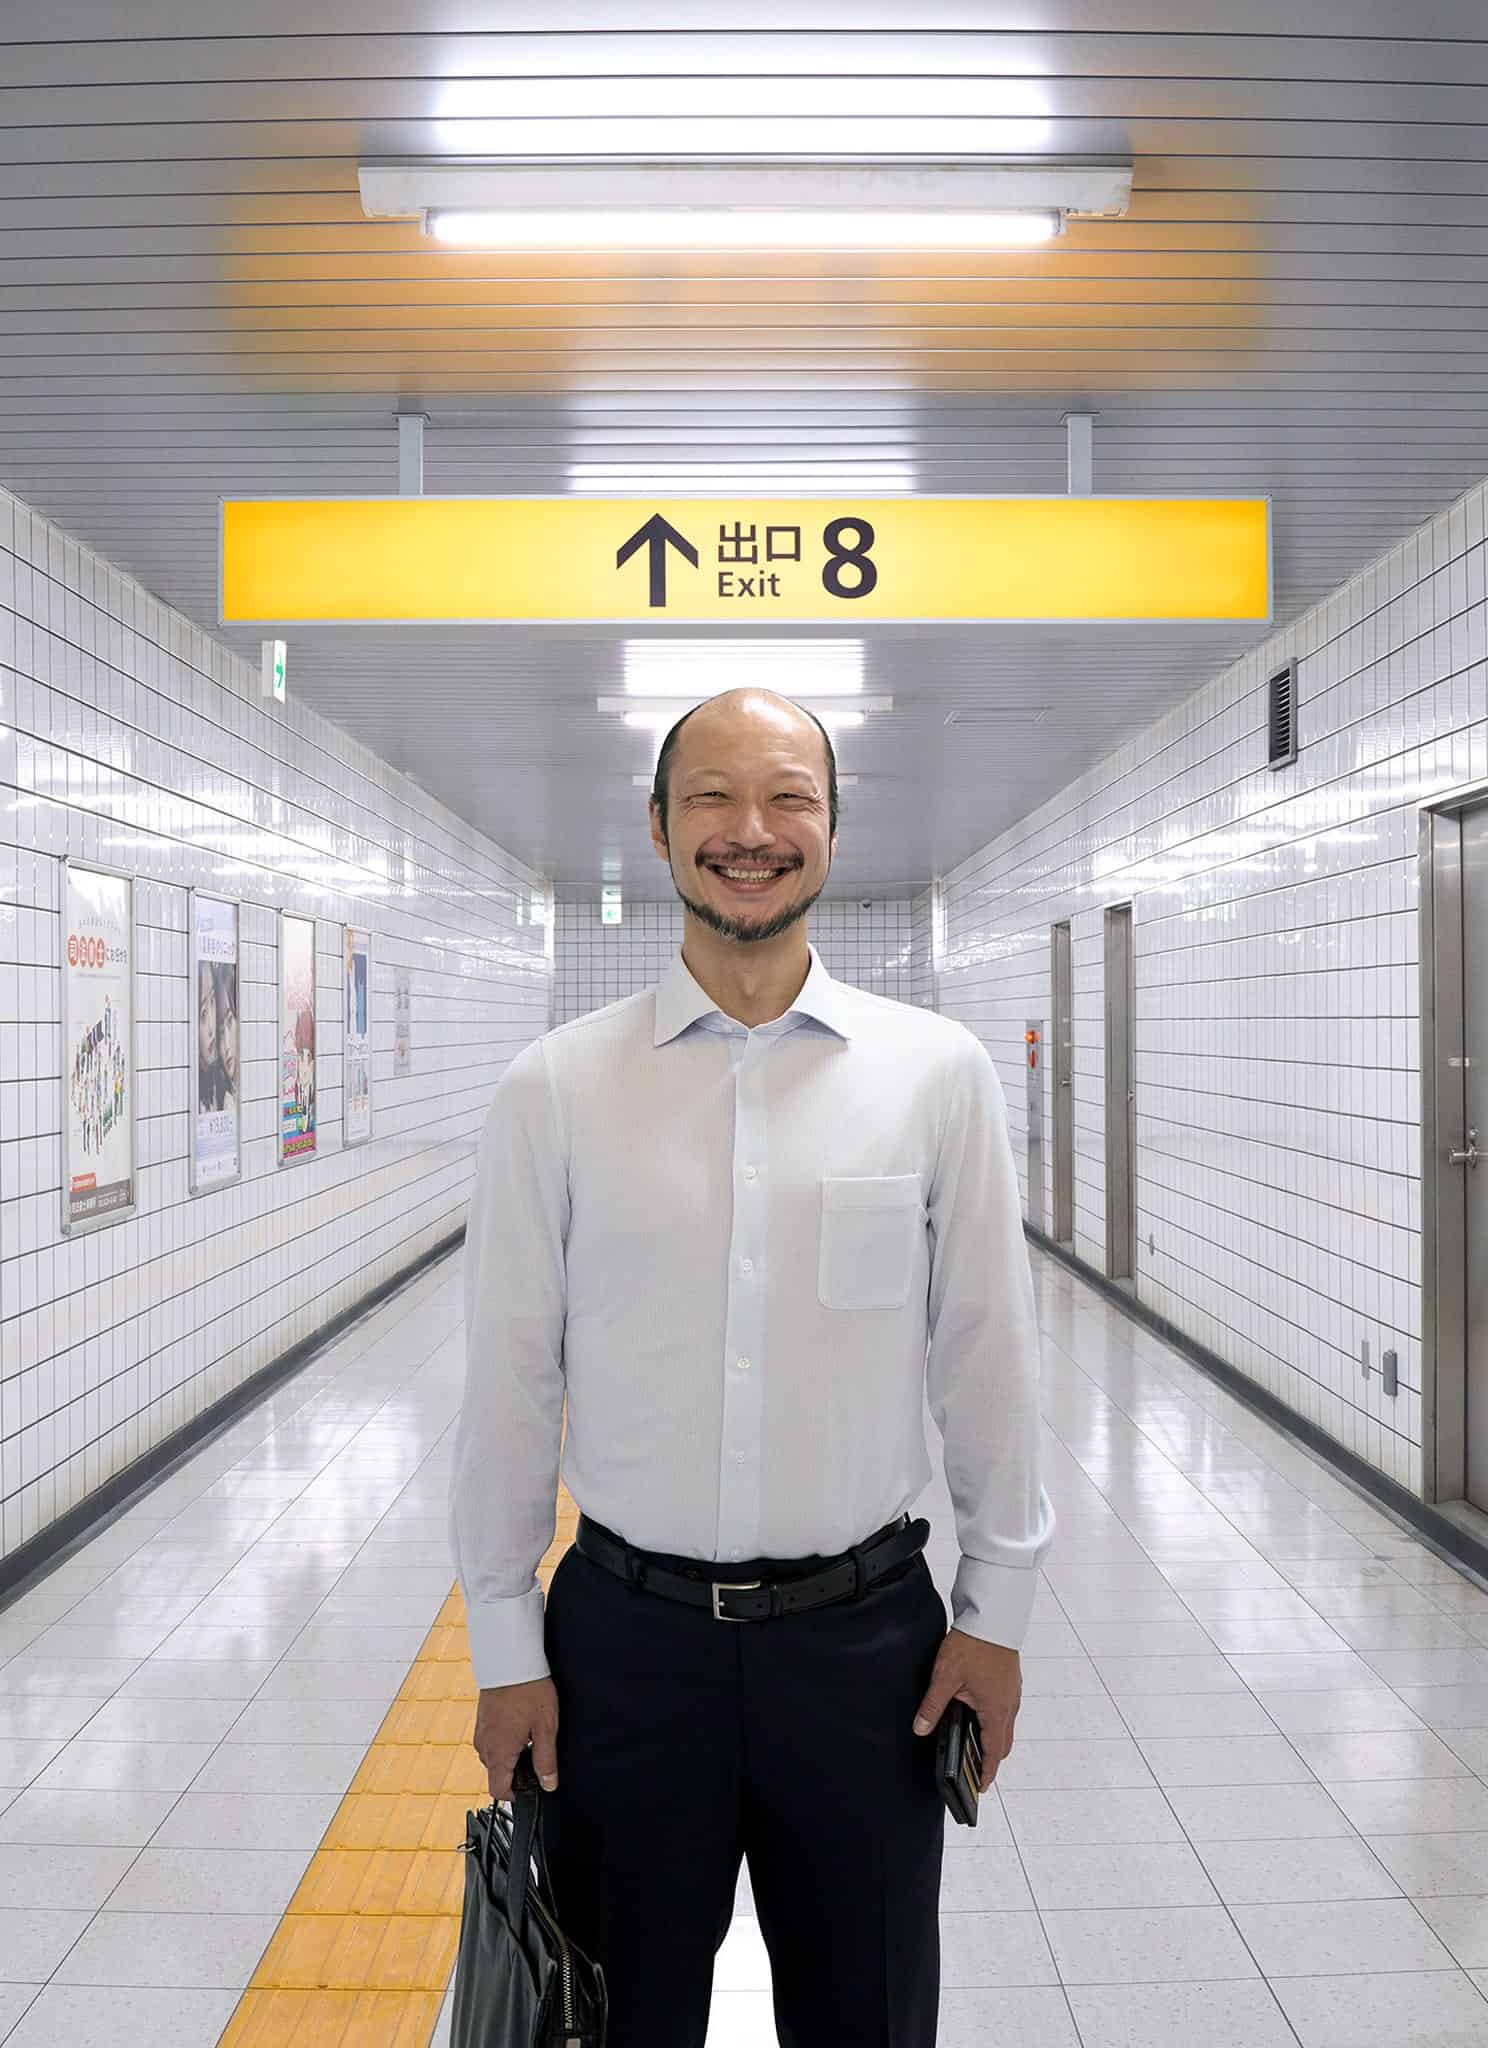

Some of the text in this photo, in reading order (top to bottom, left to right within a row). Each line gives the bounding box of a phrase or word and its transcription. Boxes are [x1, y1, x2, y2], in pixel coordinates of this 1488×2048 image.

[718, 521, 801, 565] 出口
[822, 517, 877, 599] 8
[718, 569, 781, 598] Exit
